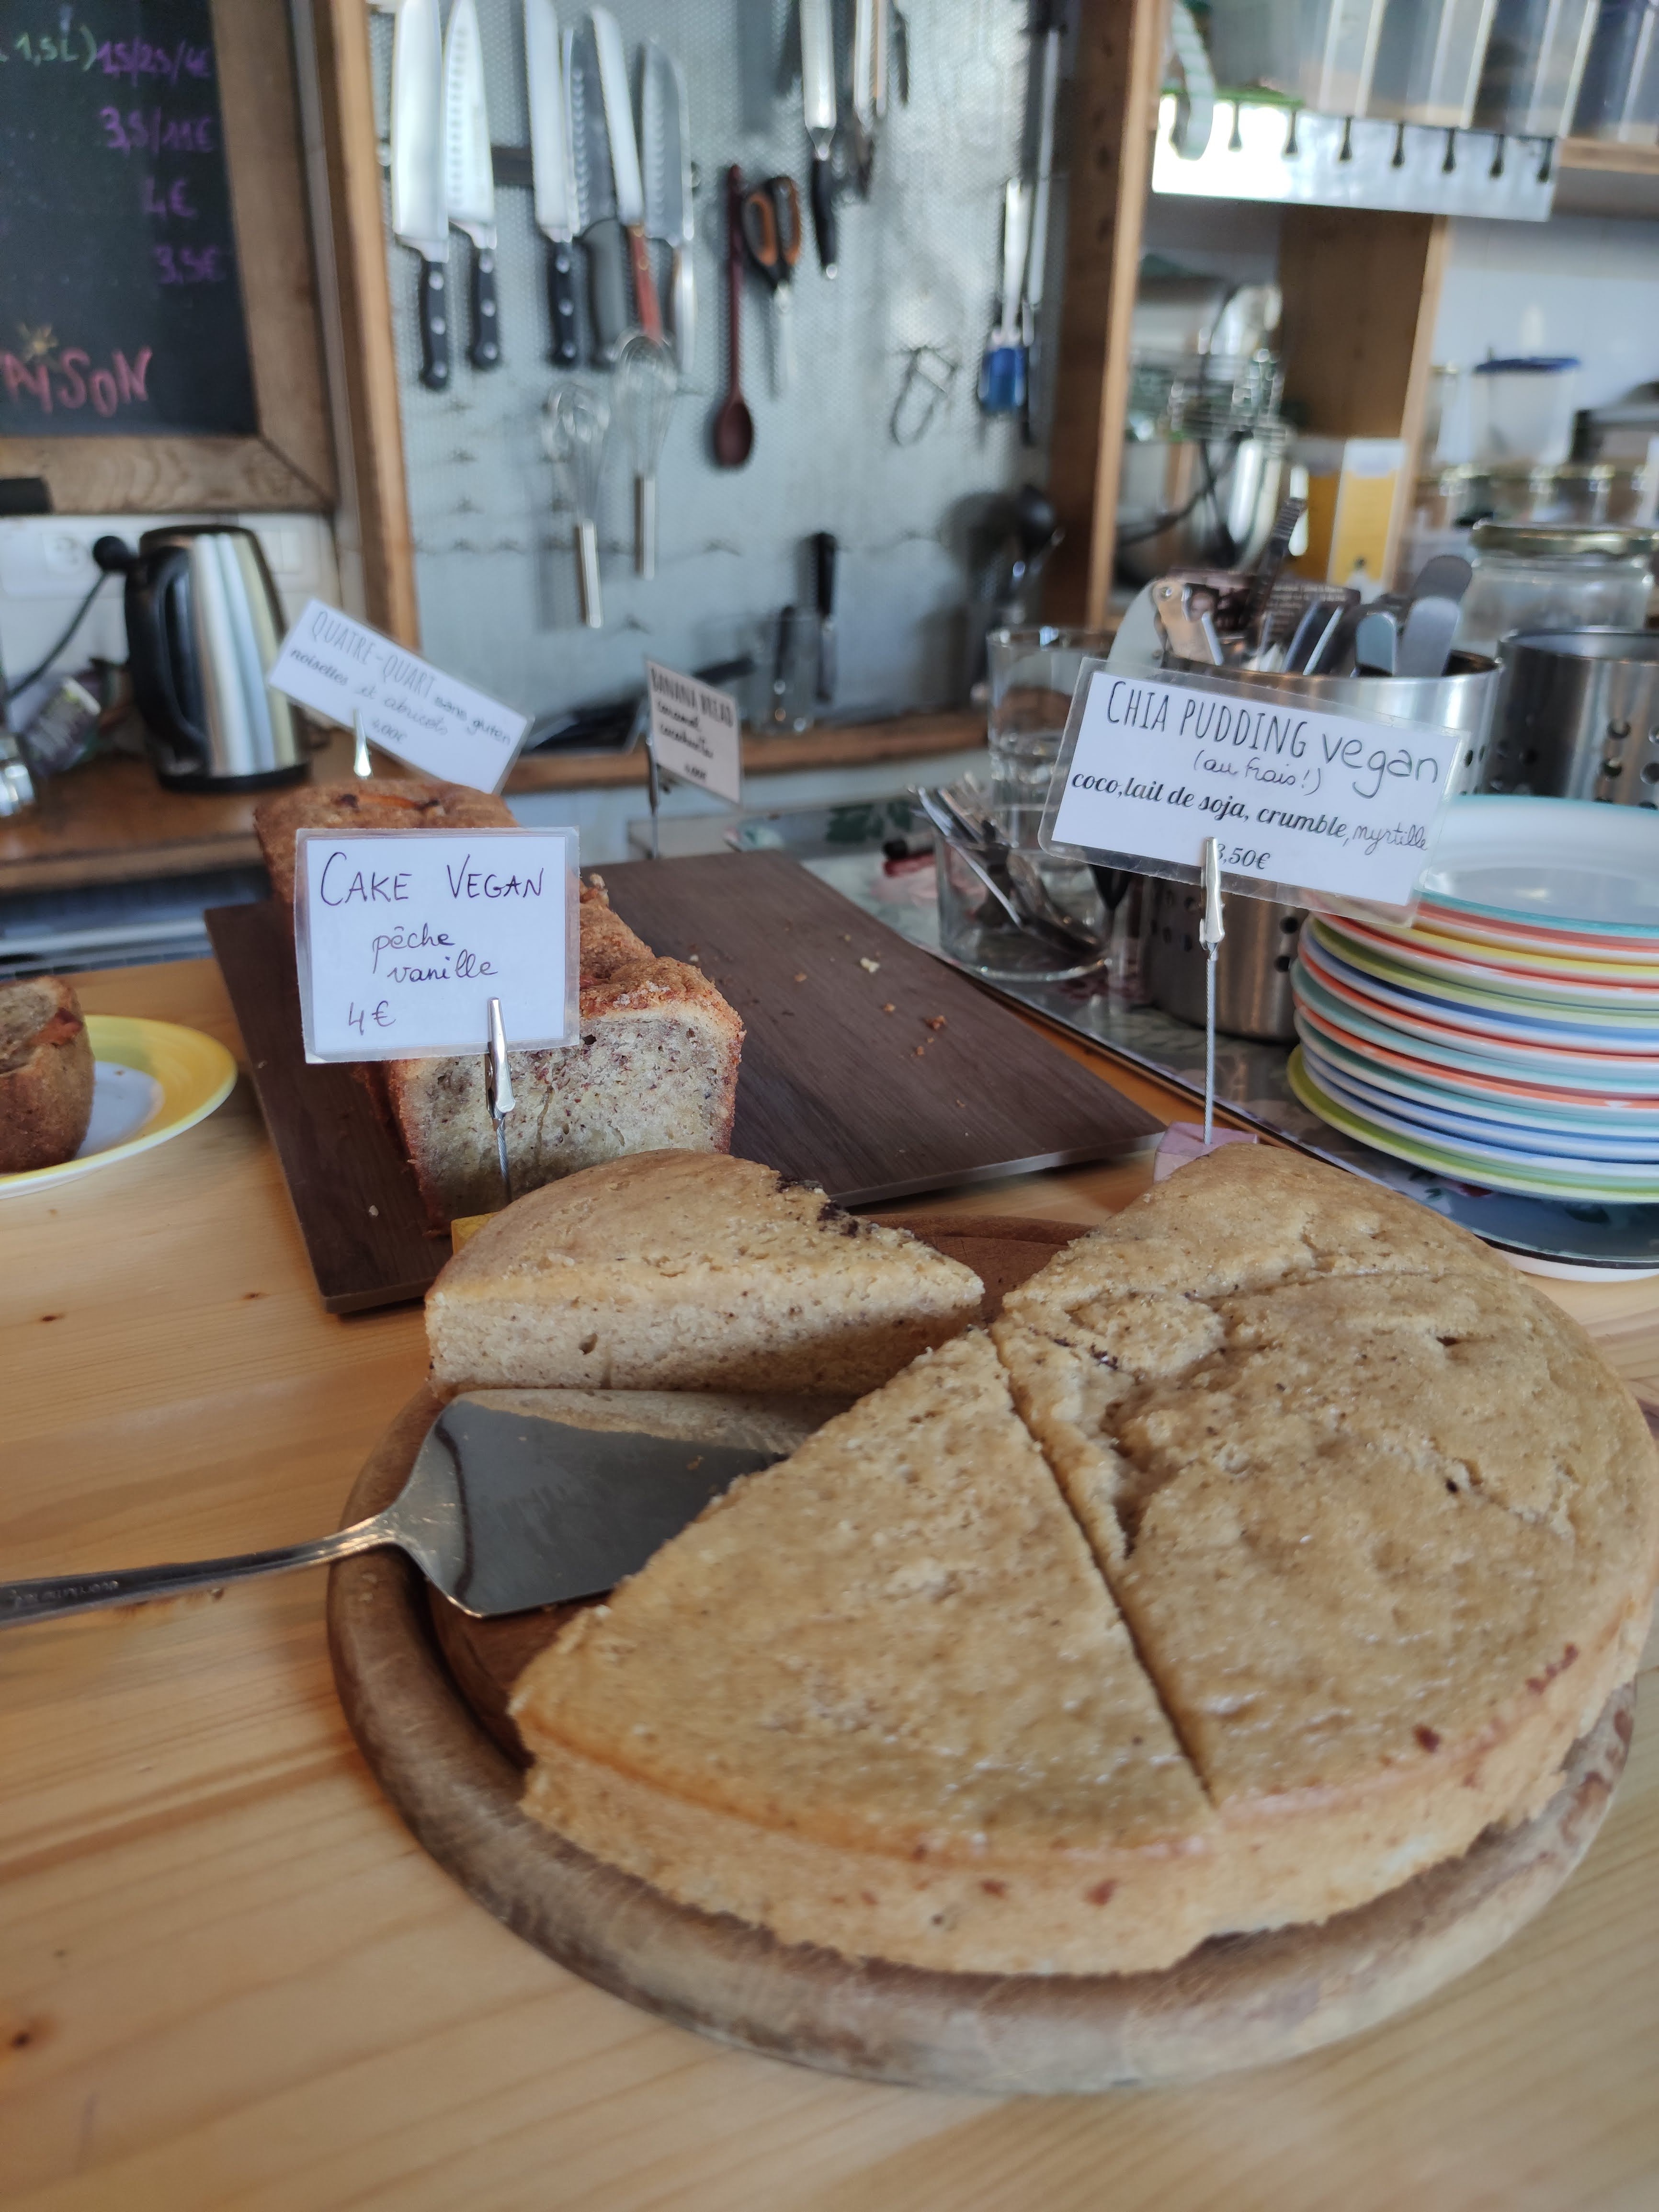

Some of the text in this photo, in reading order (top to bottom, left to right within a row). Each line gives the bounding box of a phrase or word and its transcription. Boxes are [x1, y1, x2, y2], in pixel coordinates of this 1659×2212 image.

[290, 647, 349, 686] noisettes
[1106, 681, 1438, 799] CHIA PUDDING vegan
[1193, 749, 1239, 775] (au
[1167, 787, 1195, 808] de
[1198, 795, 1250, 823] soja,
[319, 851, 545, 907] CAKE VEGAN
[372, 922, 455, 975] pêche
[386, 949, 499, 983] vanille
